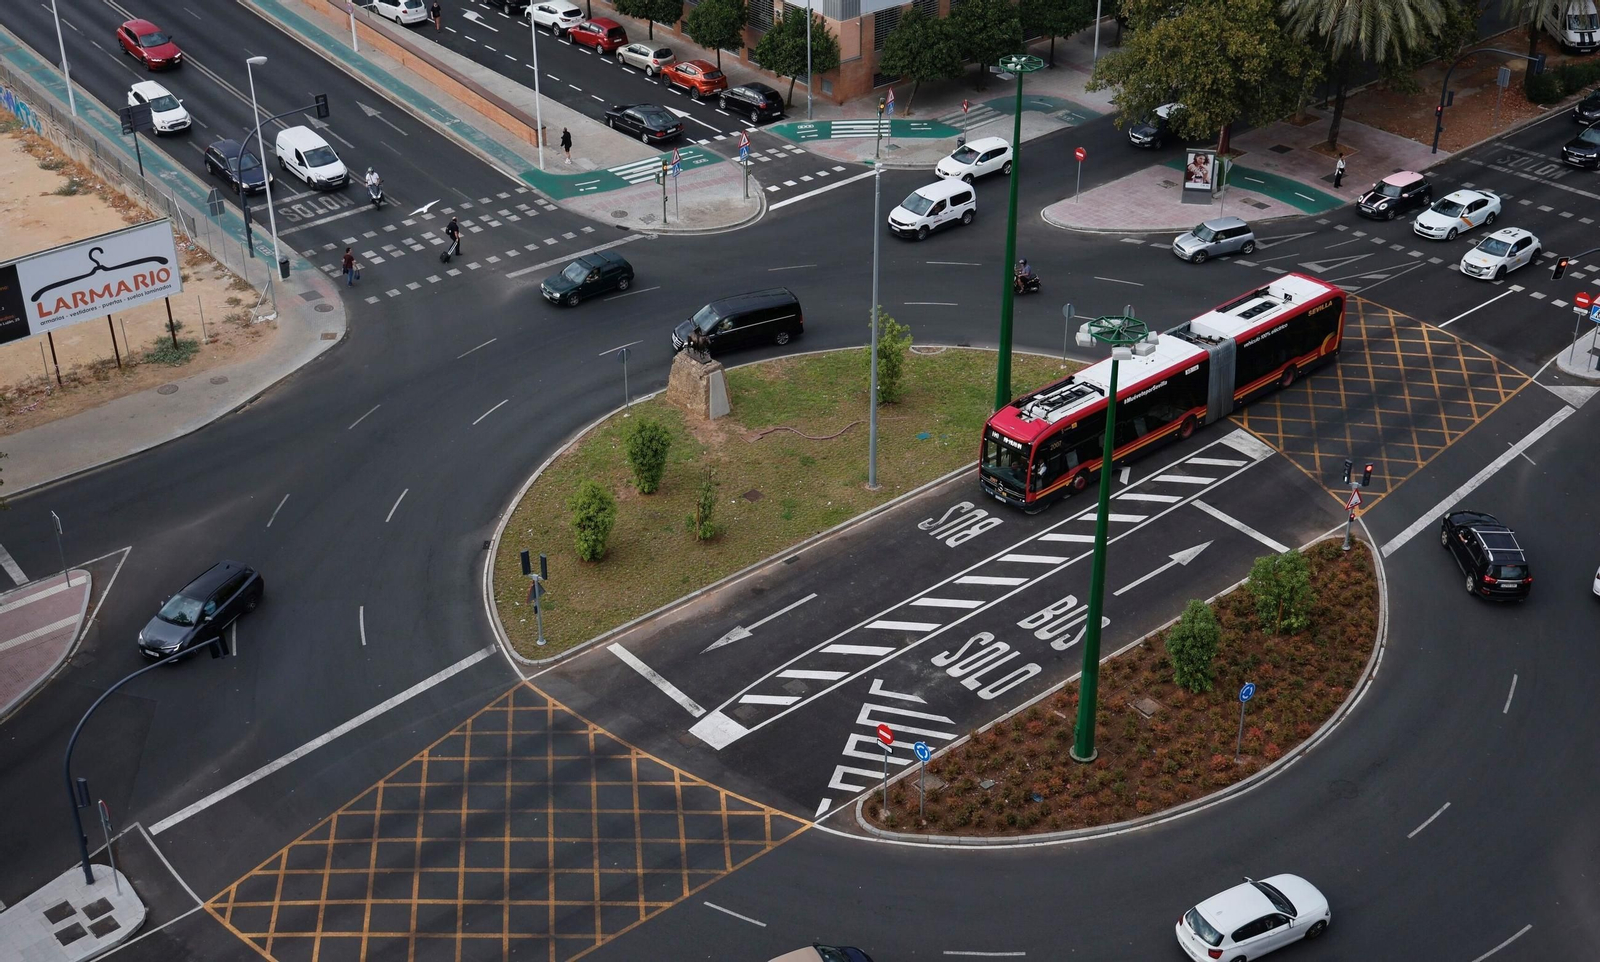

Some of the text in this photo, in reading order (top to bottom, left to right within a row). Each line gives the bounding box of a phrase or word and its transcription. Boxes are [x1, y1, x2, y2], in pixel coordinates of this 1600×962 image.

[277, 192, 355, 222] MOTOS
[36, 267, 171, 318] LARMARIO
[40, 283, 172, 326] armarios vestidores puertas suelos laminados
[1308, 300, 1333, 317] SEVILLA
[1260, 330, 1271, 340] 100%
[917, 501, 1004, 548] BUS
[1016, 594, 1111, 651] BUS
[930, 631, 1042, 700] SOLO
